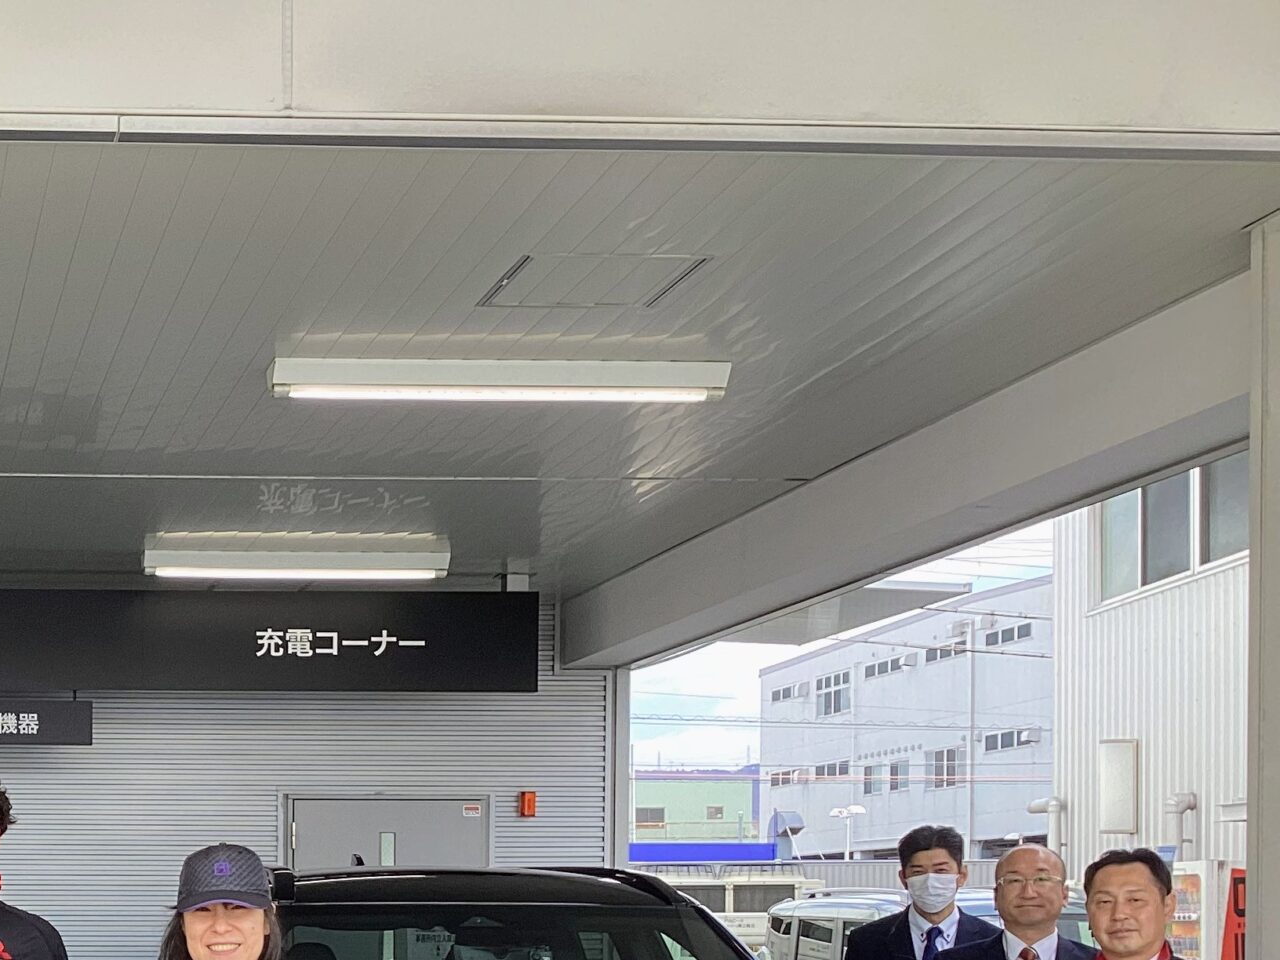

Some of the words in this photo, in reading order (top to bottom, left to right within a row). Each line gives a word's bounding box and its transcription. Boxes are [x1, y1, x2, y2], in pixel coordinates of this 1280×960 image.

[255, 628, 426, 659] 充電コーナー
